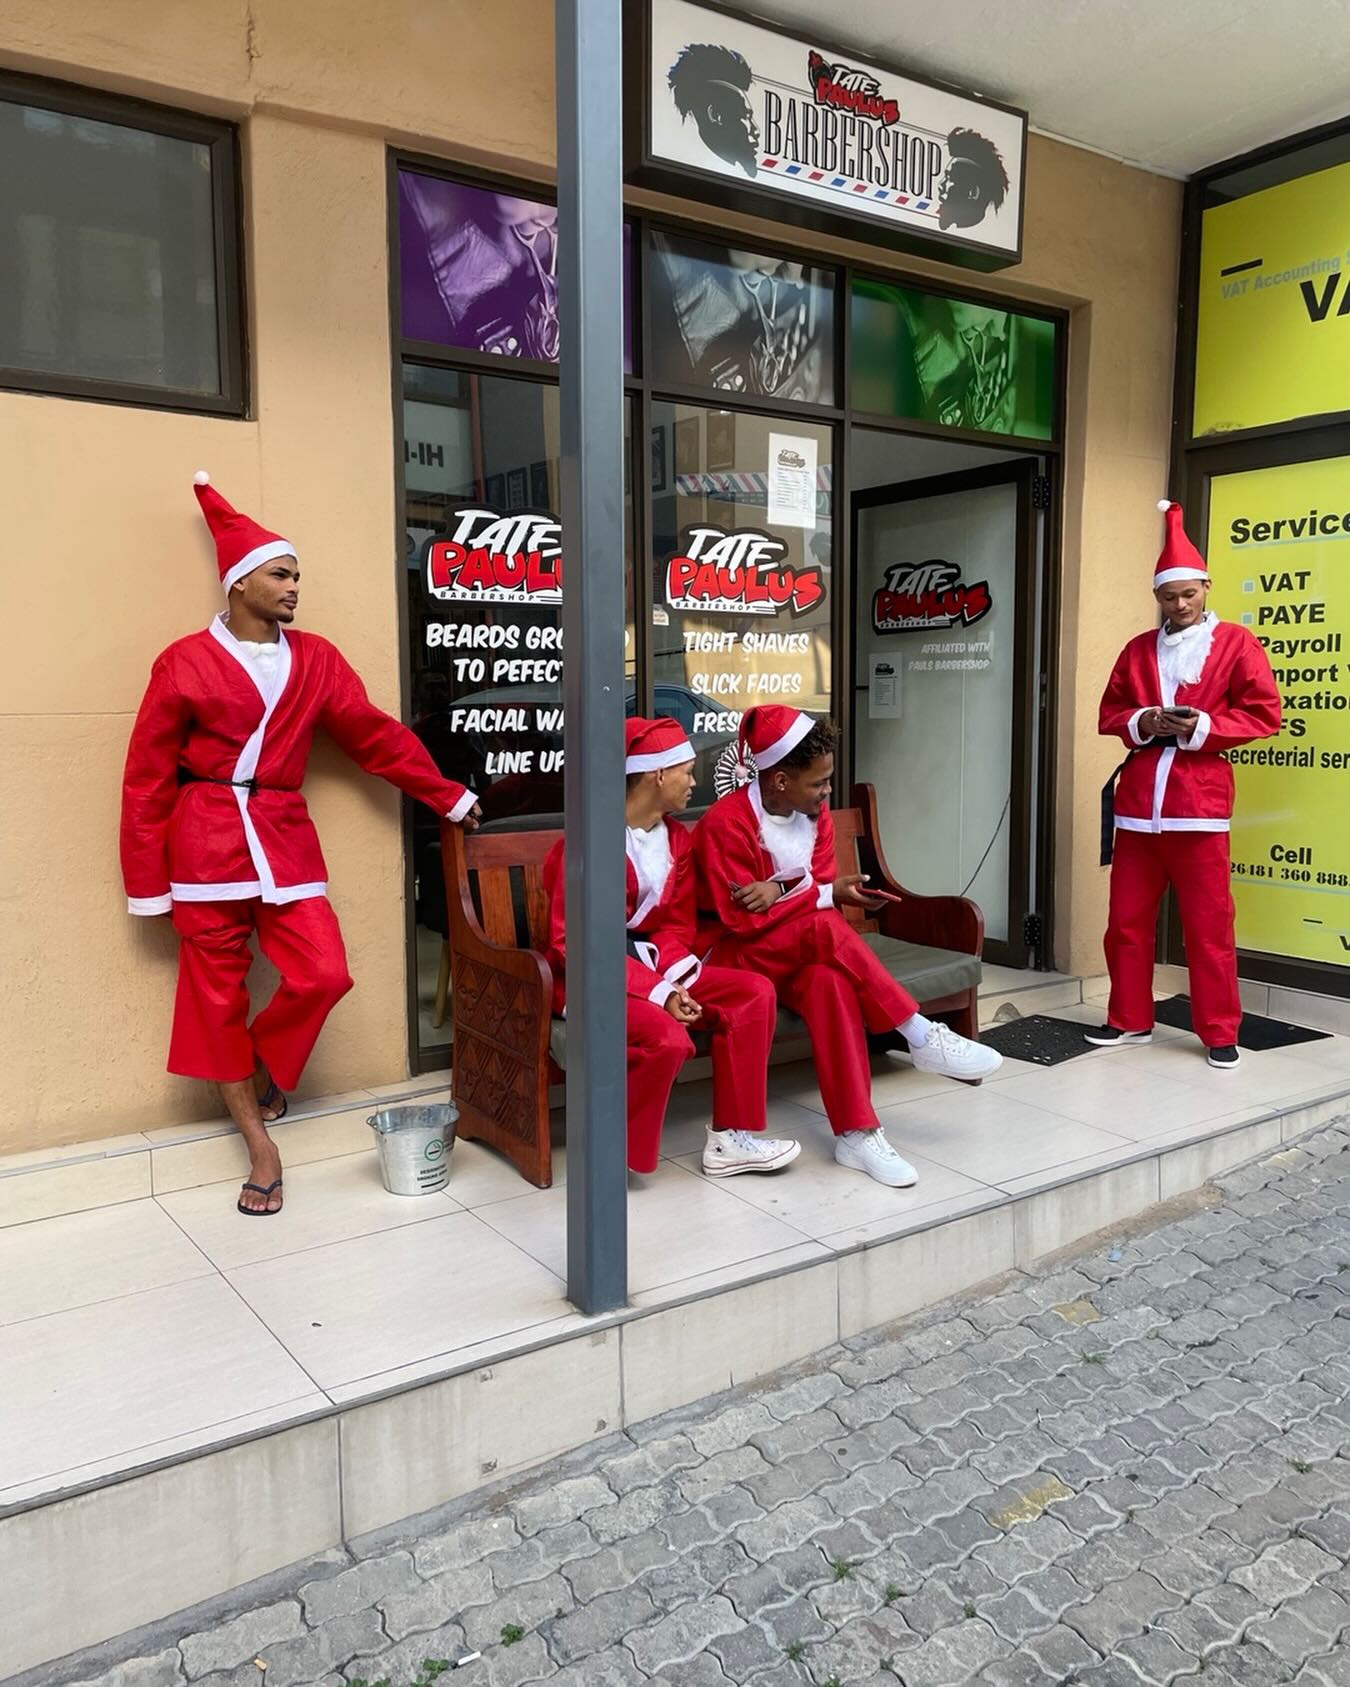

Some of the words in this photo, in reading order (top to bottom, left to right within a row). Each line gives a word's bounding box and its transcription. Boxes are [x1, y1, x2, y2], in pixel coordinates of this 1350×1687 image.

[832, 67, 880, 96] TATE
[817, 77, 899, 126] PAULUS
[763, 89, 942, 201] BARBERSHOP
[1221, 279, 1249, 299] VAT
[1254, 256, 1341, 290] Accounting
[452, 510, 562, 558] TATE
[686, 529, 784, 572] TATE
[432, 542, 563, 593] PAUL
[887, 565, 958, 595] TATE
[670, 557, 822, 608] PAULUS
[1259, 571, 1311, 593] VAT
[440, 591, 535, 601] BARBERSHOP
[675, 601, 751, 611] BARBERSHOP
[876, 583, 990, 623] PAULUS
[1258, 603, 1325, 626] PAYE
[426, 623, 520, 649] BEARDS
[683, 631, 738, 653] TIGHT
[742, 632, 809, 655] SHAVES
[920, 643, 966, 654] AFFILIATED
[967, 642, 991, 653] WITH
[453, 658, 486, 683] TO
[493, 658, 564, 683] PEFEC
[691, 672, 743, 695] SLICK
[746, 672, 802, 694] FADES
[1282, 691, 1350, 710] xatio
[450, 708, 529, 733] FACIAL
[693, 711, 743, 733] FRES
[485, 750, 534, 775] LINE
[1269, 845, 1312, 865] Cell
[1281, 868, 1311, 882] 360
[1316, 872, 1350, 886] 888
